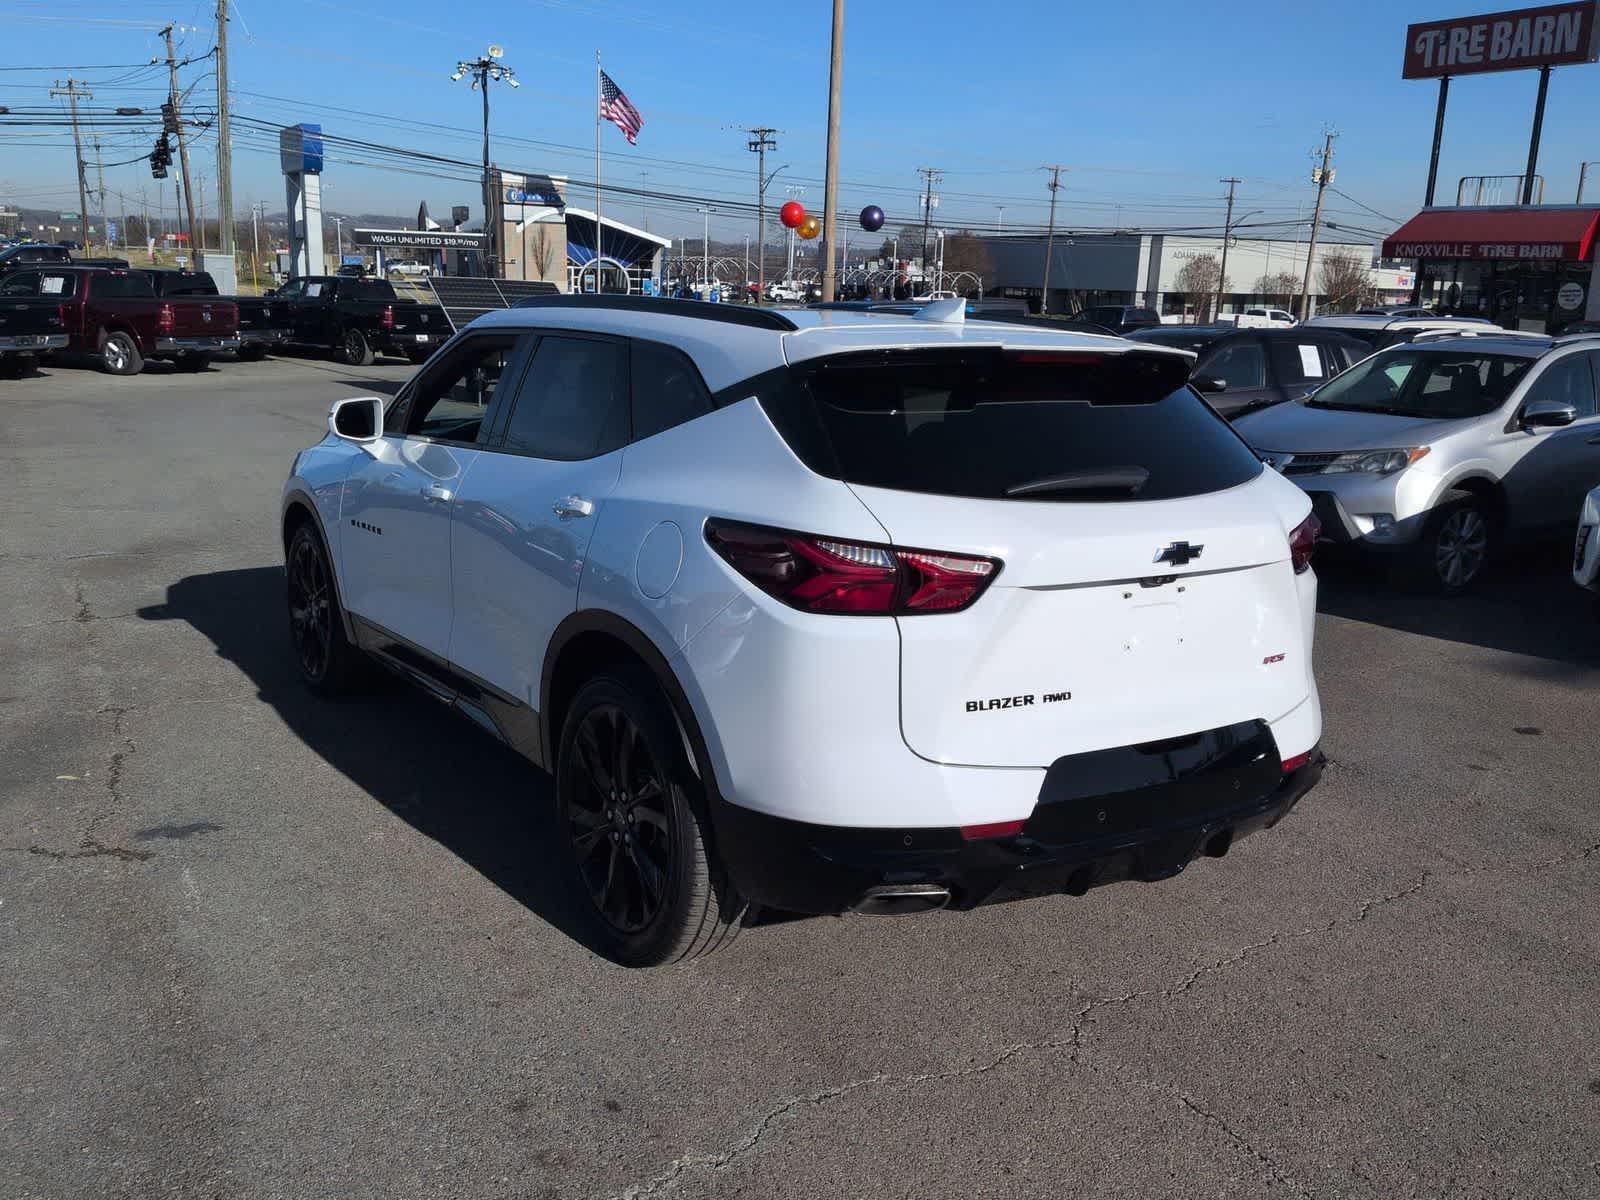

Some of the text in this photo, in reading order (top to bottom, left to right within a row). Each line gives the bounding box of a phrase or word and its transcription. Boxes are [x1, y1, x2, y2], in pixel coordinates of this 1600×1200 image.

[1490, 11, 1582, 61] BARN
[371, 235, 478, 247] WASH UNLIMITED $19./mo
[1395, 244, 1472, 257] KNOXVILLE
[1519, 244, 1563, 258] BARN
[966, 691, 1071, 712] BLAZER AWD
